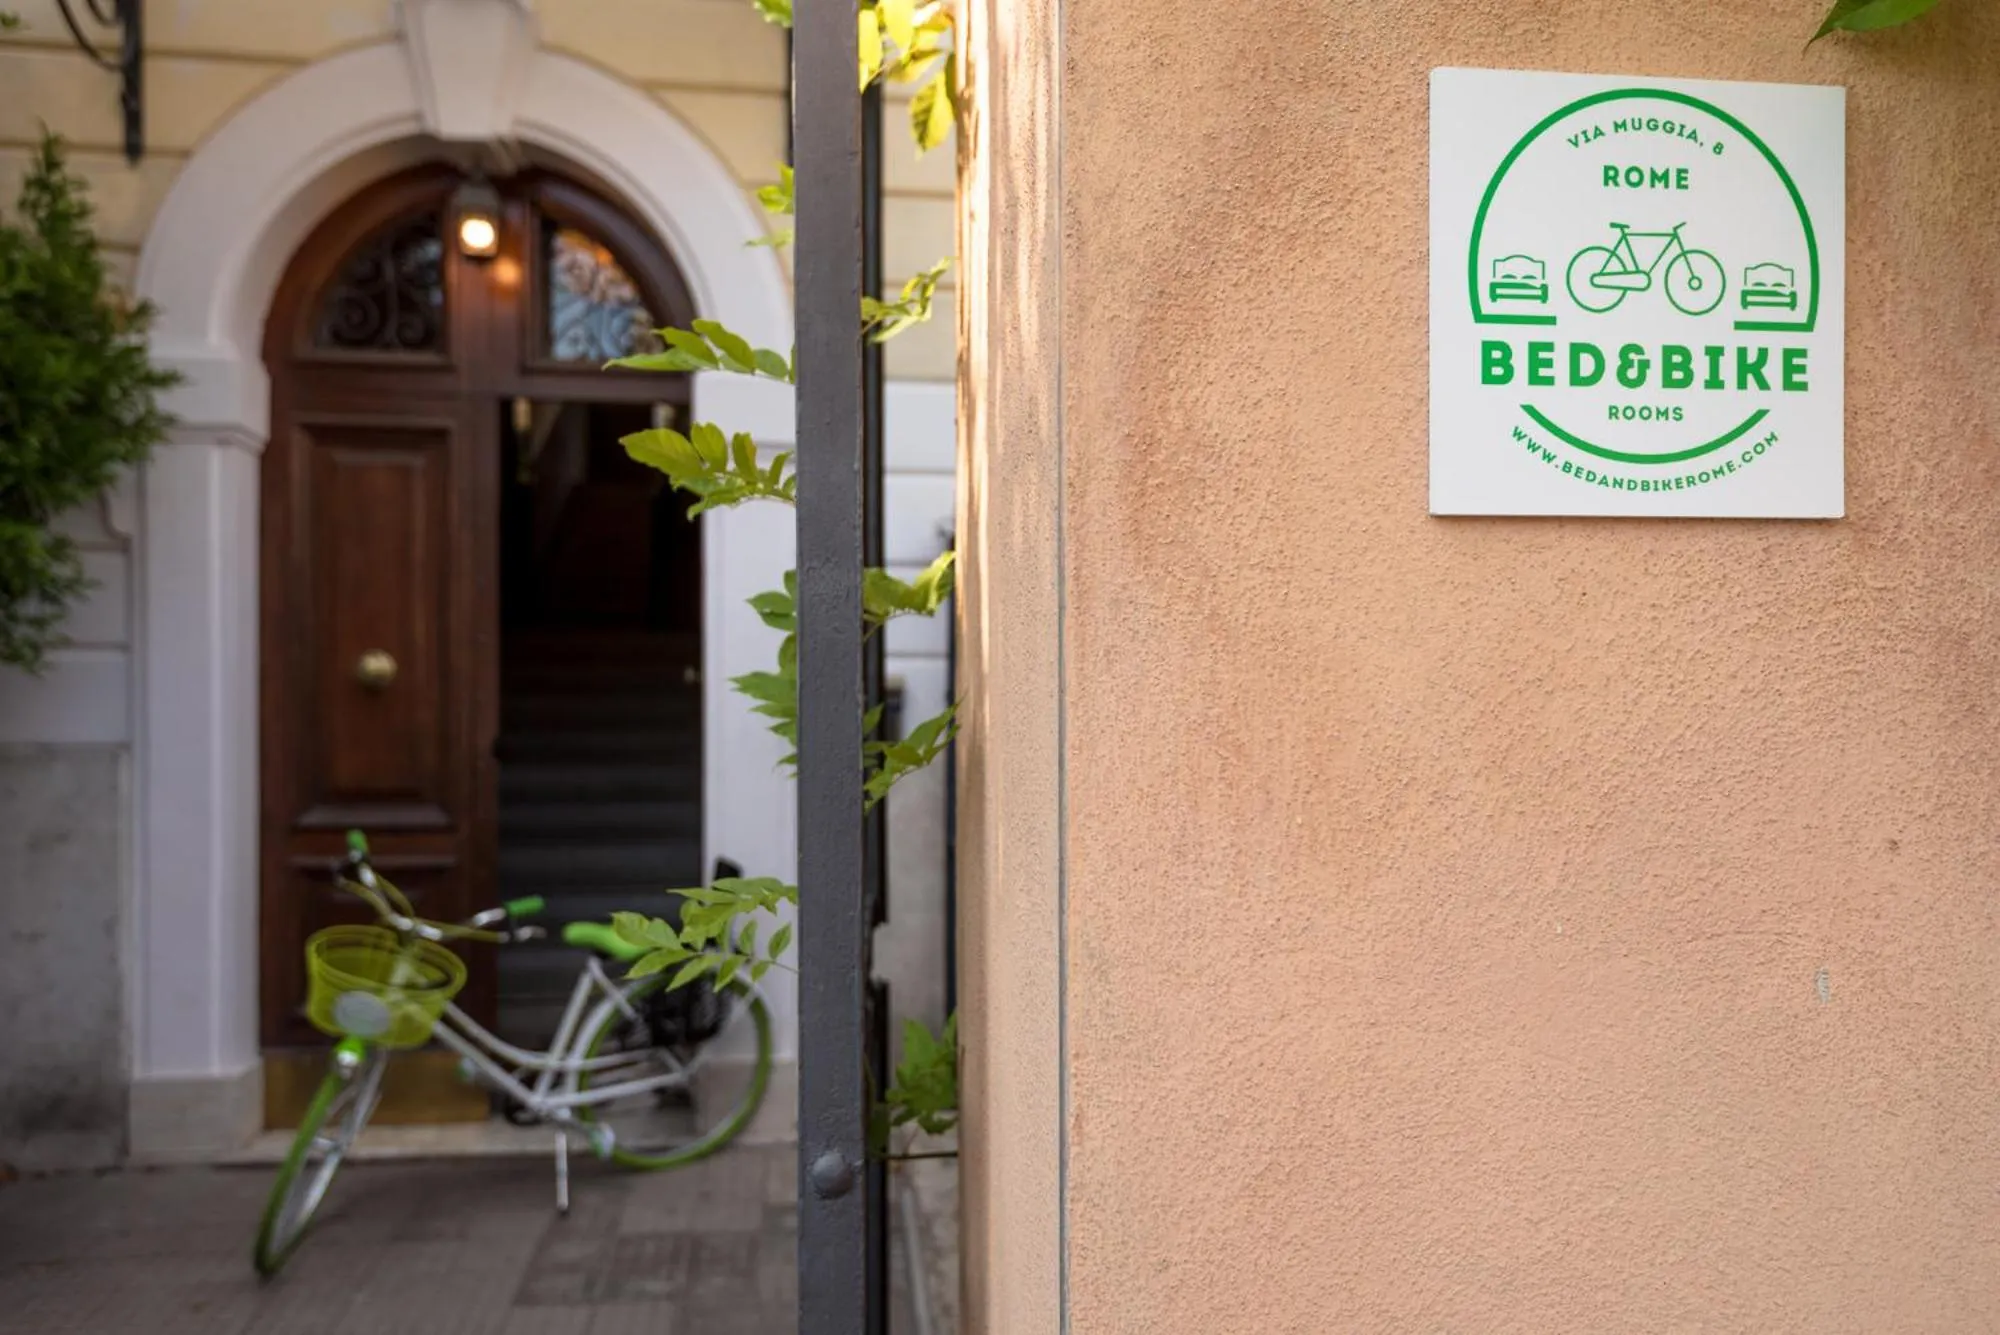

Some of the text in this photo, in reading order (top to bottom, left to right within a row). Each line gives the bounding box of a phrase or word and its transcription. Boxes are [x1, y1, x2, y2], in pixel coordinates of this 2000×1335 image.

[1567, 125, 1606, 149] VIA
[1711, 141, 1725, 156] 8
[1602, 164, 1690, 190] ROME
[1480, 339, 1809, 392] BED&BIKE
[1607, 405, 1685, 422] ROOMS
[1511, 425, 1779, 492] WWW.BEDANDBIKEROME.COM
